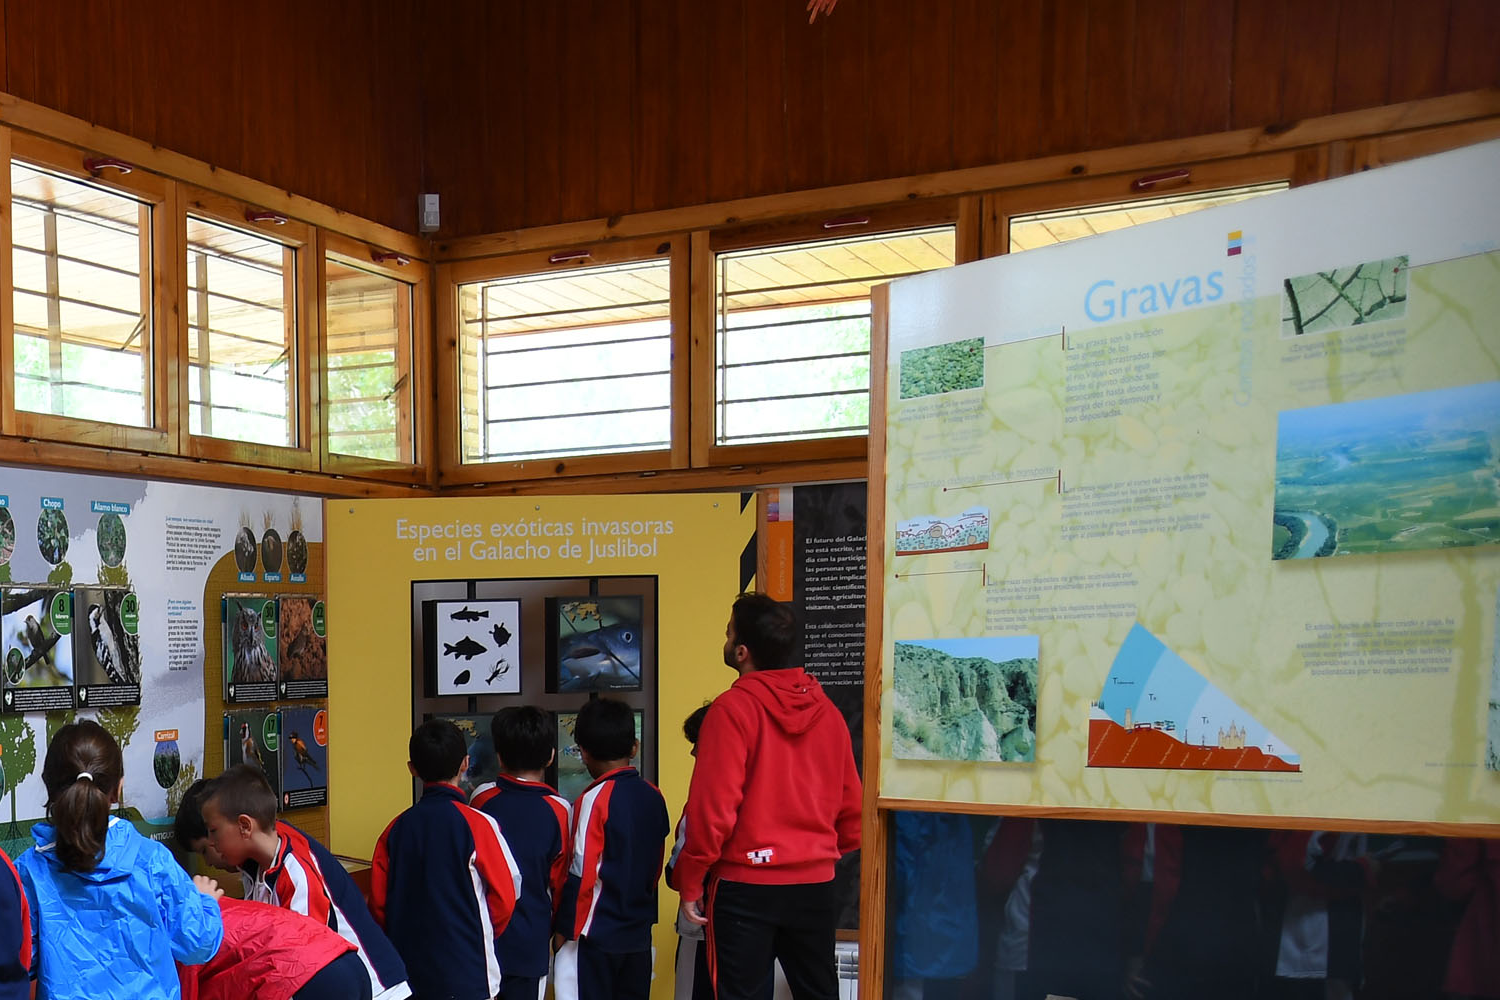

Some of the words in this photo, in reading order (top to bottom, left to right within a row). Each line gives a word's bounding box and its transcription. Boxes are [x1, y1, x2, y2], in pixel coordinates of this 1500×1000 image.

[1083, 269, 1224, 323] Gravas
[44, 499, 61, 510] Chopo
[396, 519, 482, 544] Especies
[490, 517, 574, 538] exóticas
[582, 517, 674, 536] invasoras
[413, 546, 437, 561] en
[445, 541, 462, 561] el
[469, 540, 551, 560] Galacho
[558, 539, 582, 559] de
[588, 537, 658, 564] Juslibol
[837, 555, 866, 563] participa
[59, 599, 64, 613] 8
[126, 600, 135, 613] 30
